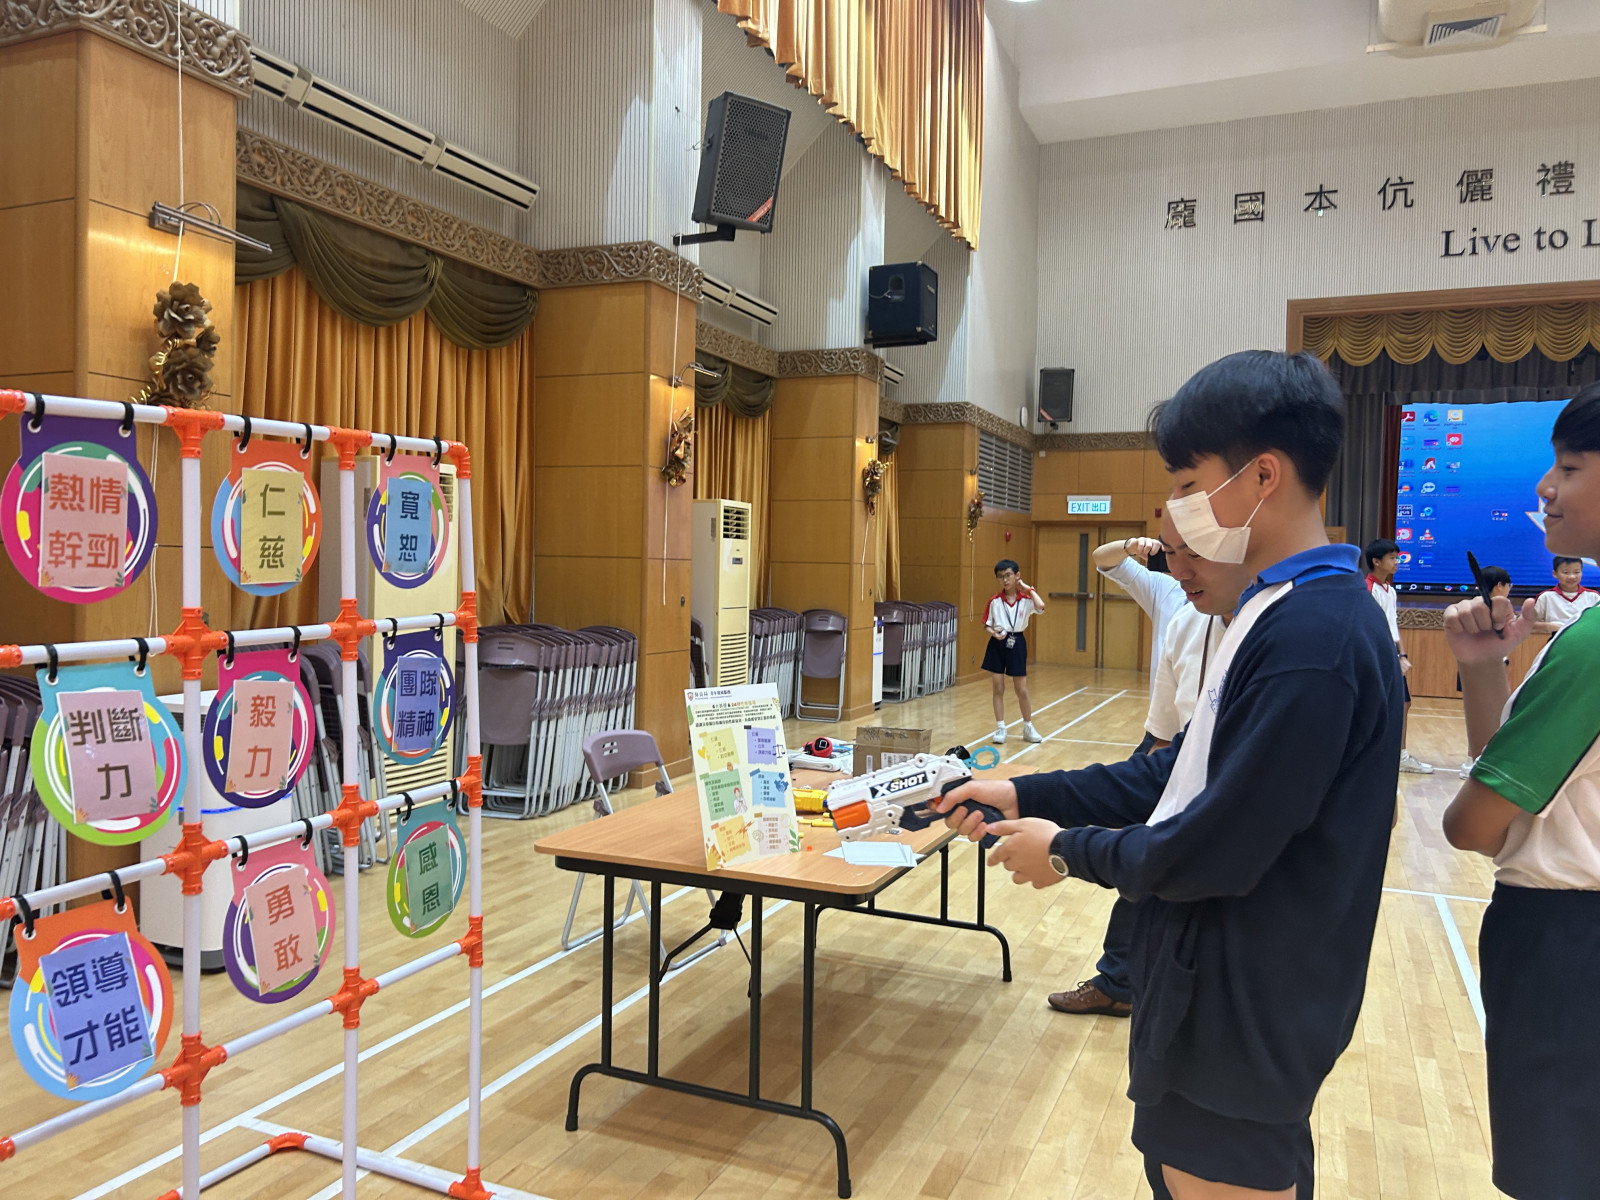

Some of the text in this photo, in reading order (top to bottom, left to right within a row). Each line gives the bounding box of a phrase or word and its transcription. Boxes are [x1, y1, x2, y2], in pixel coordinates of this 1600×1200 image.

[1440, 227, 1521, 258] Live
[1533, 226, 1569, 250] to
[49, 473, 122, 514] 熱情
[1071, 502, 1107, 512] EXIT 出口
[258, 483, 286, 569] 仁慈
[47, 530, 119, 569] 幹勁
[400, 669, 437, 697] 團隊
[69, 707, 143, 746] 判斷
[396, 709, 435, 738] 精神
[97, 763, 132, 800] 力
[418, 841, 441, 916] 感恩
[265, 884, 303, 972] 勇敢
[51, 951, 129, 1008] 領導
[63, 1004, 143, 1067] 才能
